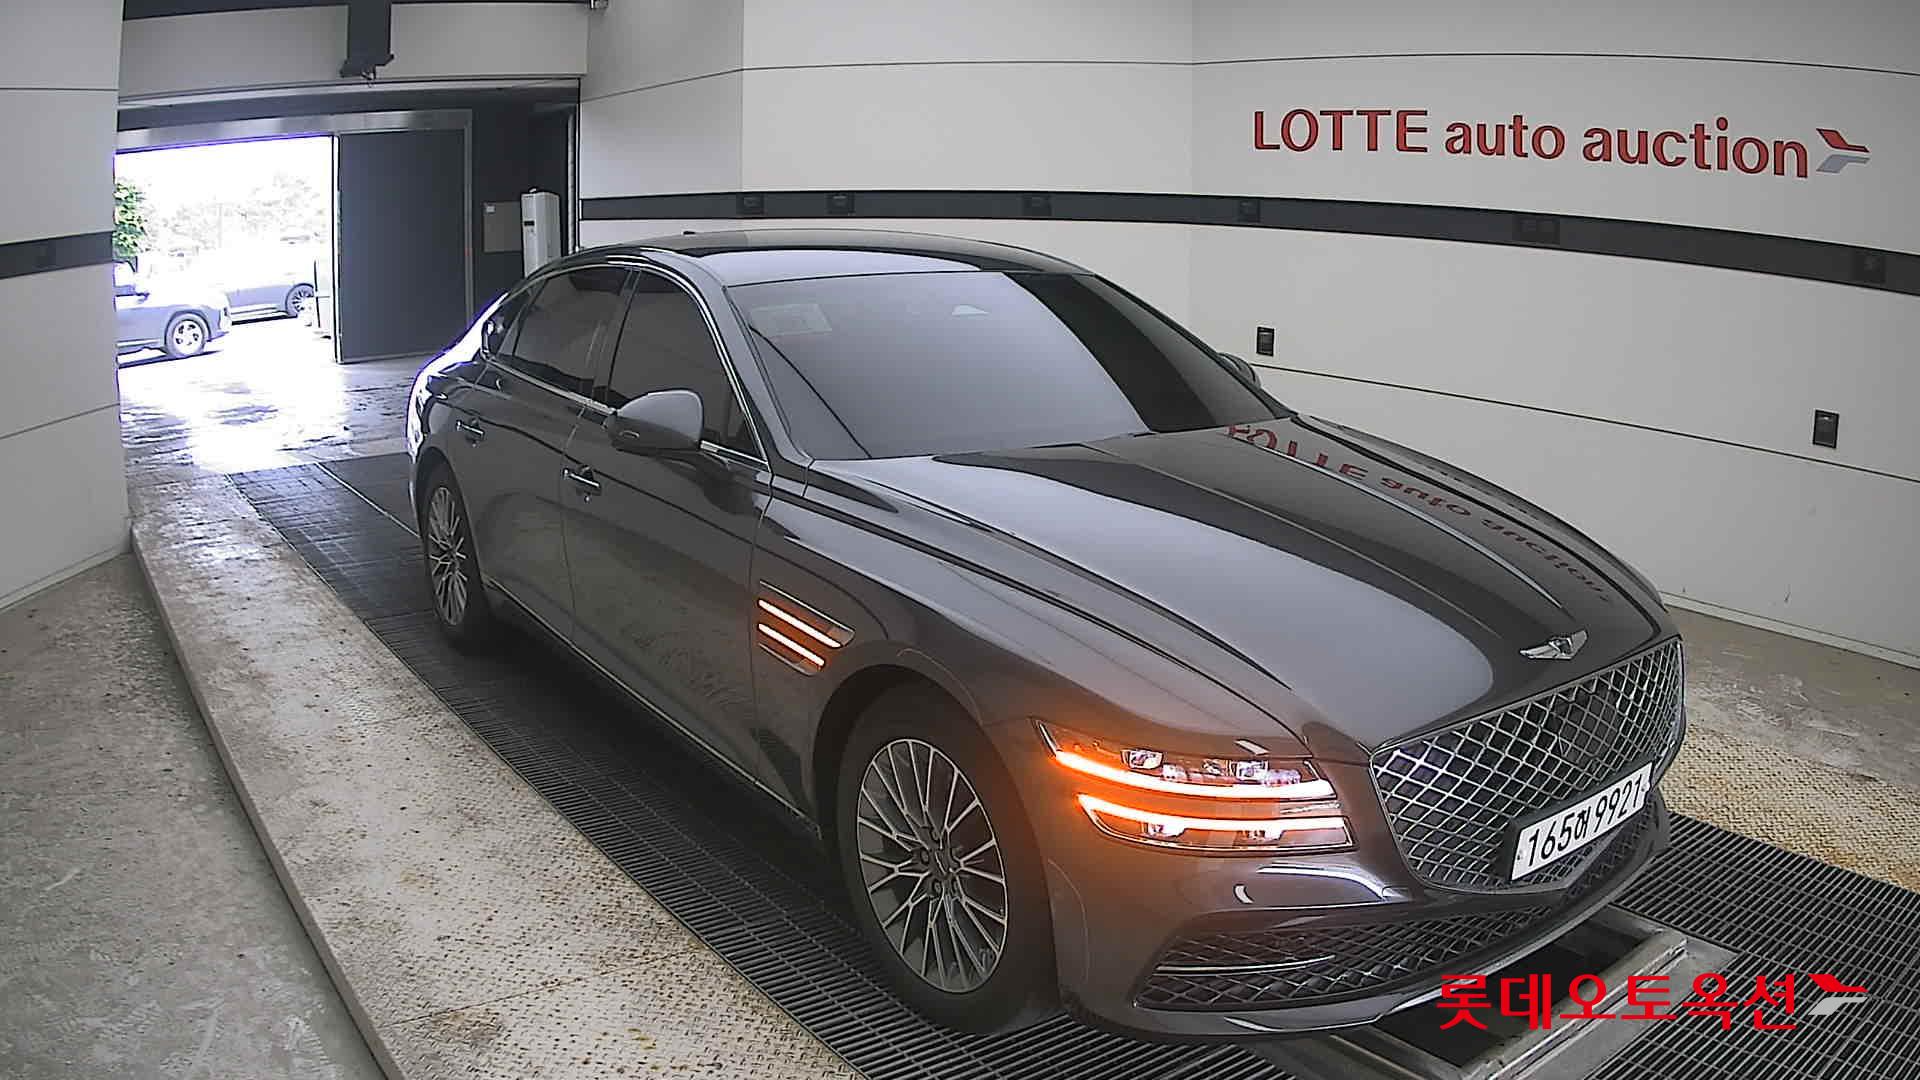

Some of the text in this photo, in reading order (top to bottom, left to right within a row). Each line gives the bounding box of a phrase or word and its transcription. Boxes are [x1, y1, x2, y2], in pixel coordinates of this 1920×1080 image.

[1253, 108, 1809, 178] LOTTE auto auction
